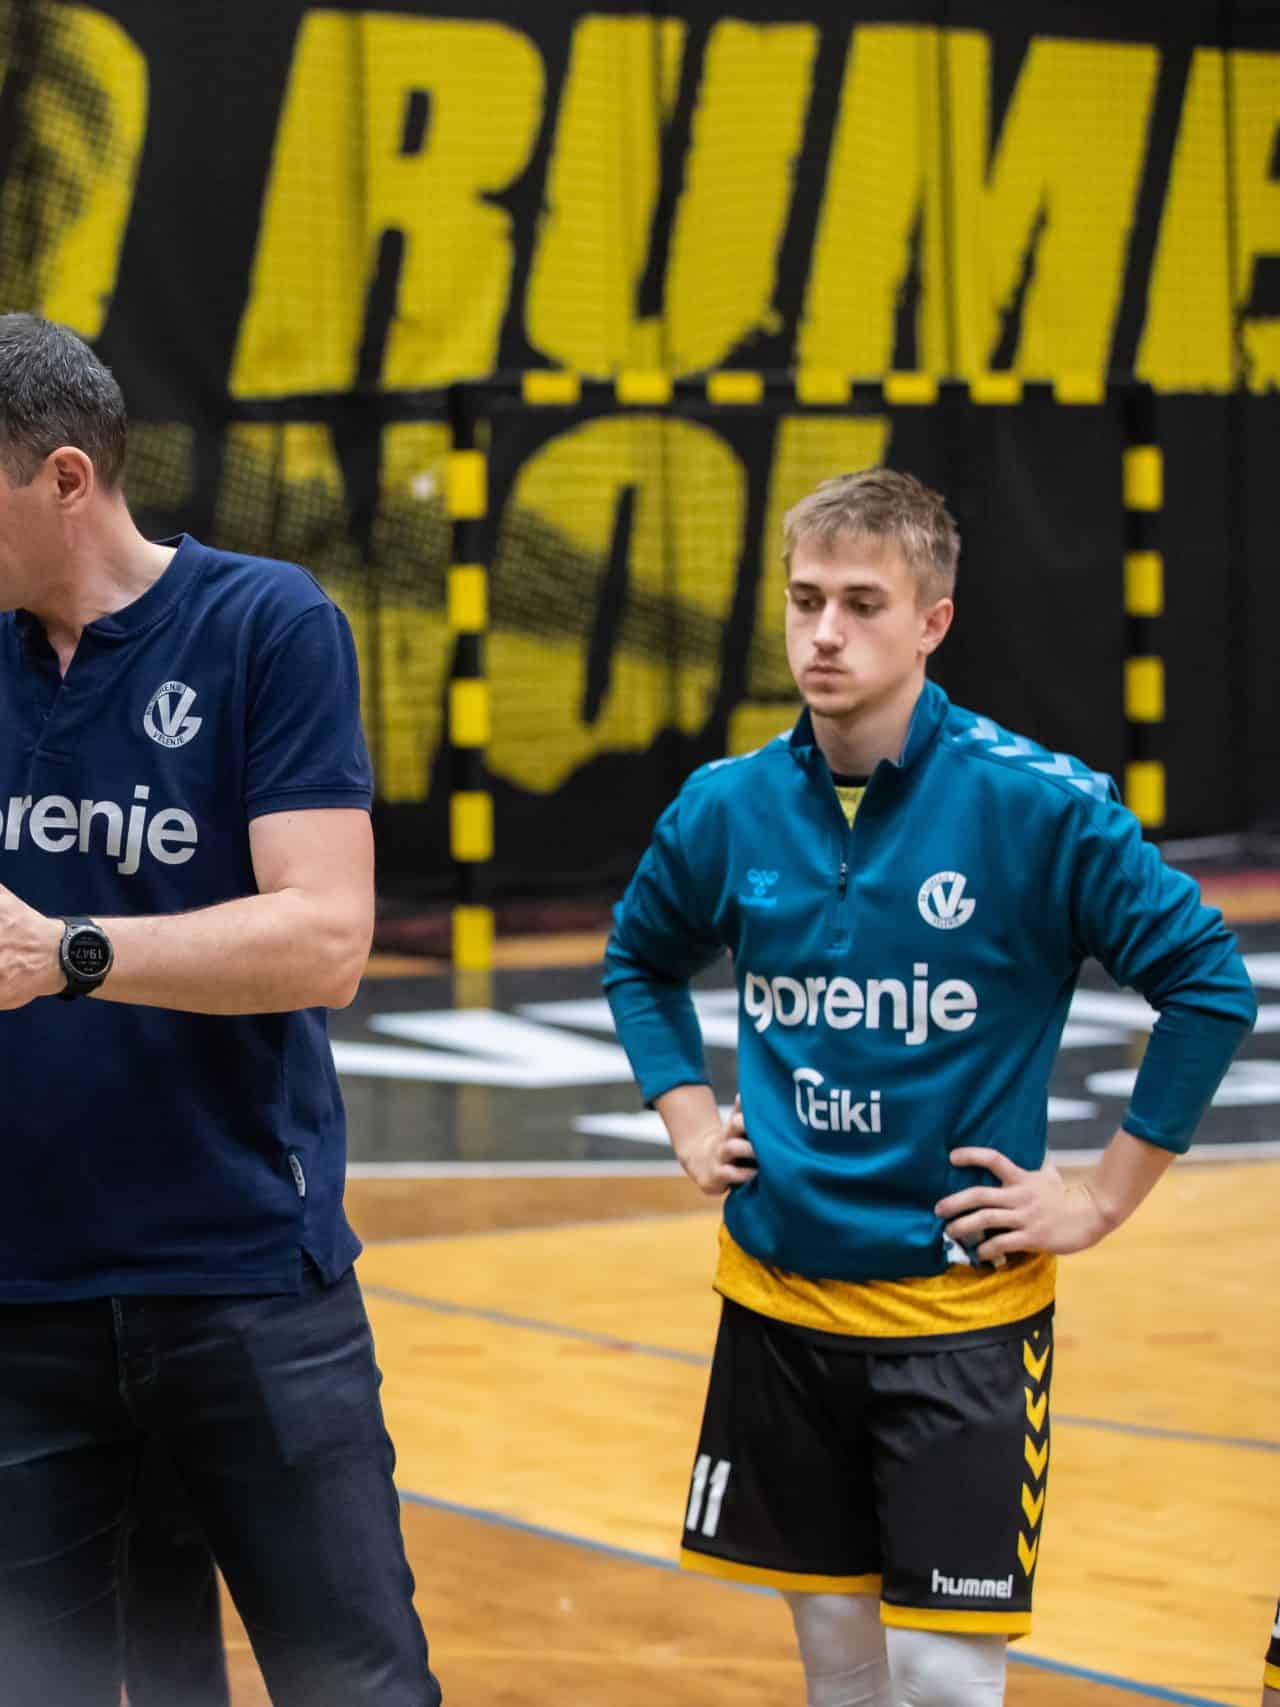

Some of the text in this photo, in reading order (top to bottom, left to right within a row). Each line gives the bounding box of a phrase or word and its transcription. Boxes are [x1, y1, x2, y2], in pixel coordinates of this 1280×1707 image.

[744, 962, 978, 1046] gorenje
[685, 1453, 732, 1537] 11
[932, 1568, 1014, 1599] hummel
